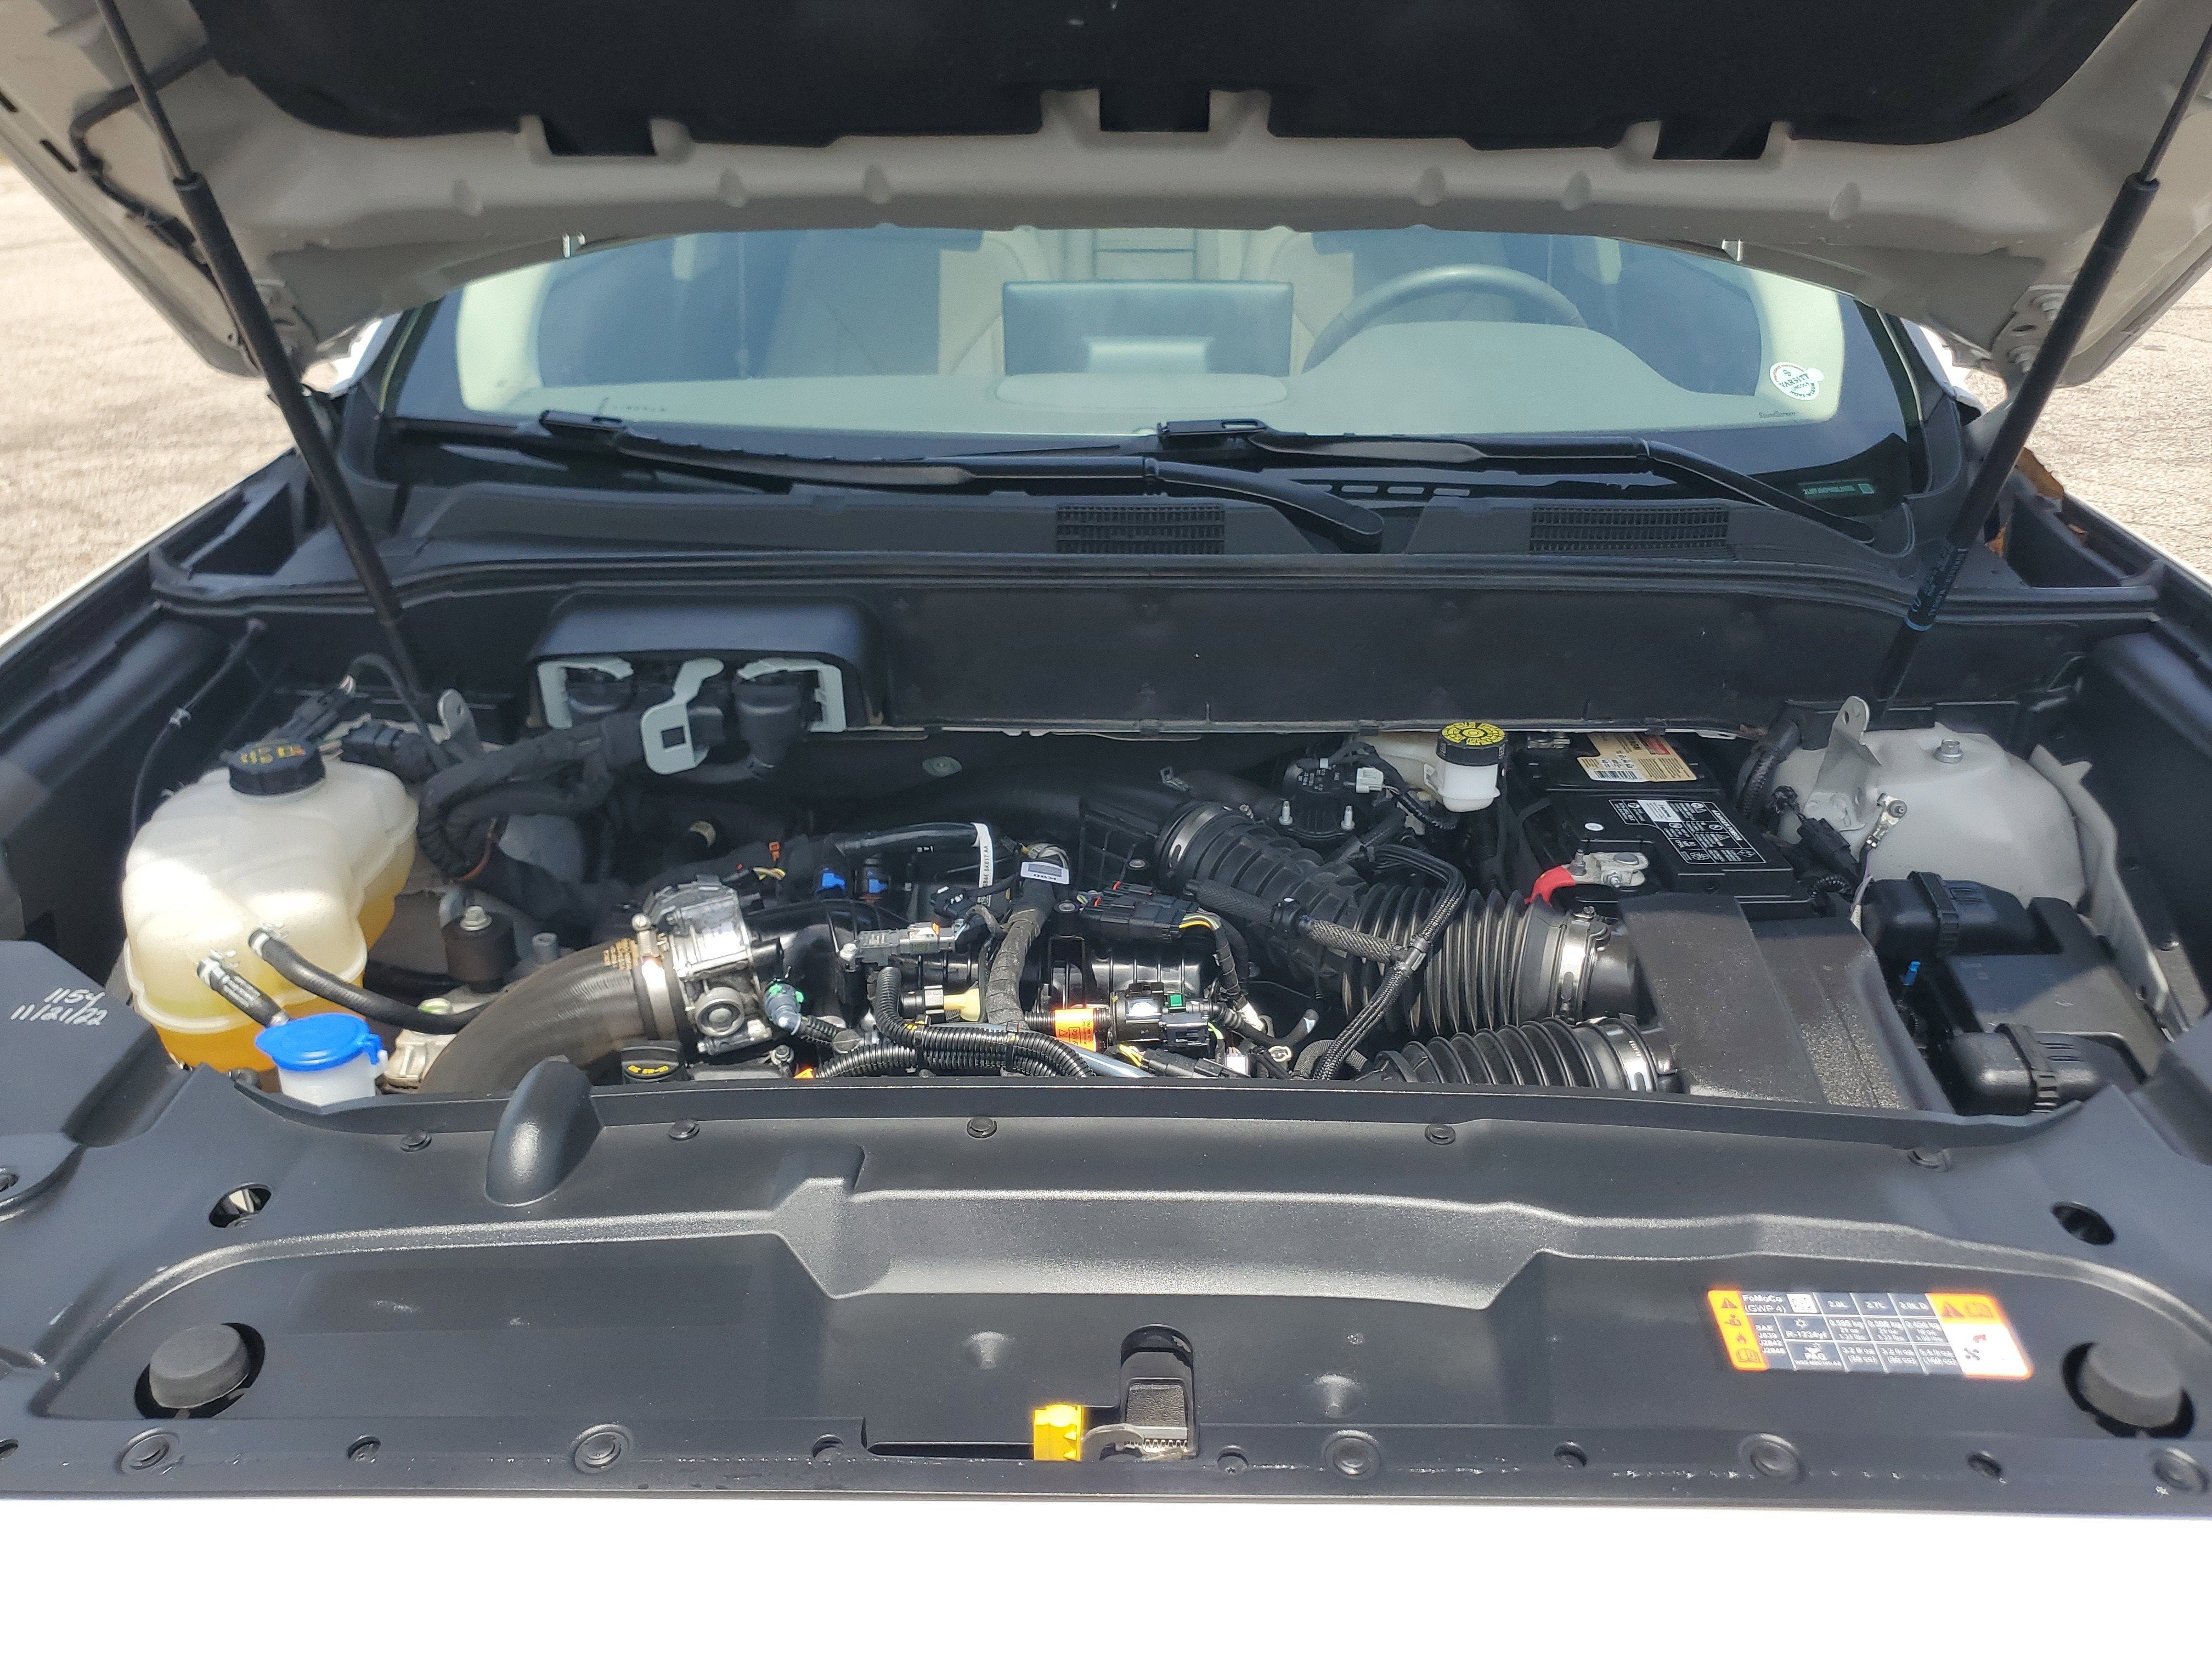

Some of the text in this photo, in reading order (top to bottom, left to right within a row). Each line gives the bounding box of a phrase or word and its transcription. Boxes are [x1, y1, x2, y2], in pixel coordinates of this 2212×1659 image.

[1779, 373, 1809, 387] VARSITY
[1726, 826, 1743, 841] POISON
[1742, 1294, 1783, 1302] FoMoCo
[1745, 1305, 1786, 1313] (GWP 4)
[1785, 1330, 1827, 1339] R-1234yf
[1804, 1352, 1827, 1361] PAG
